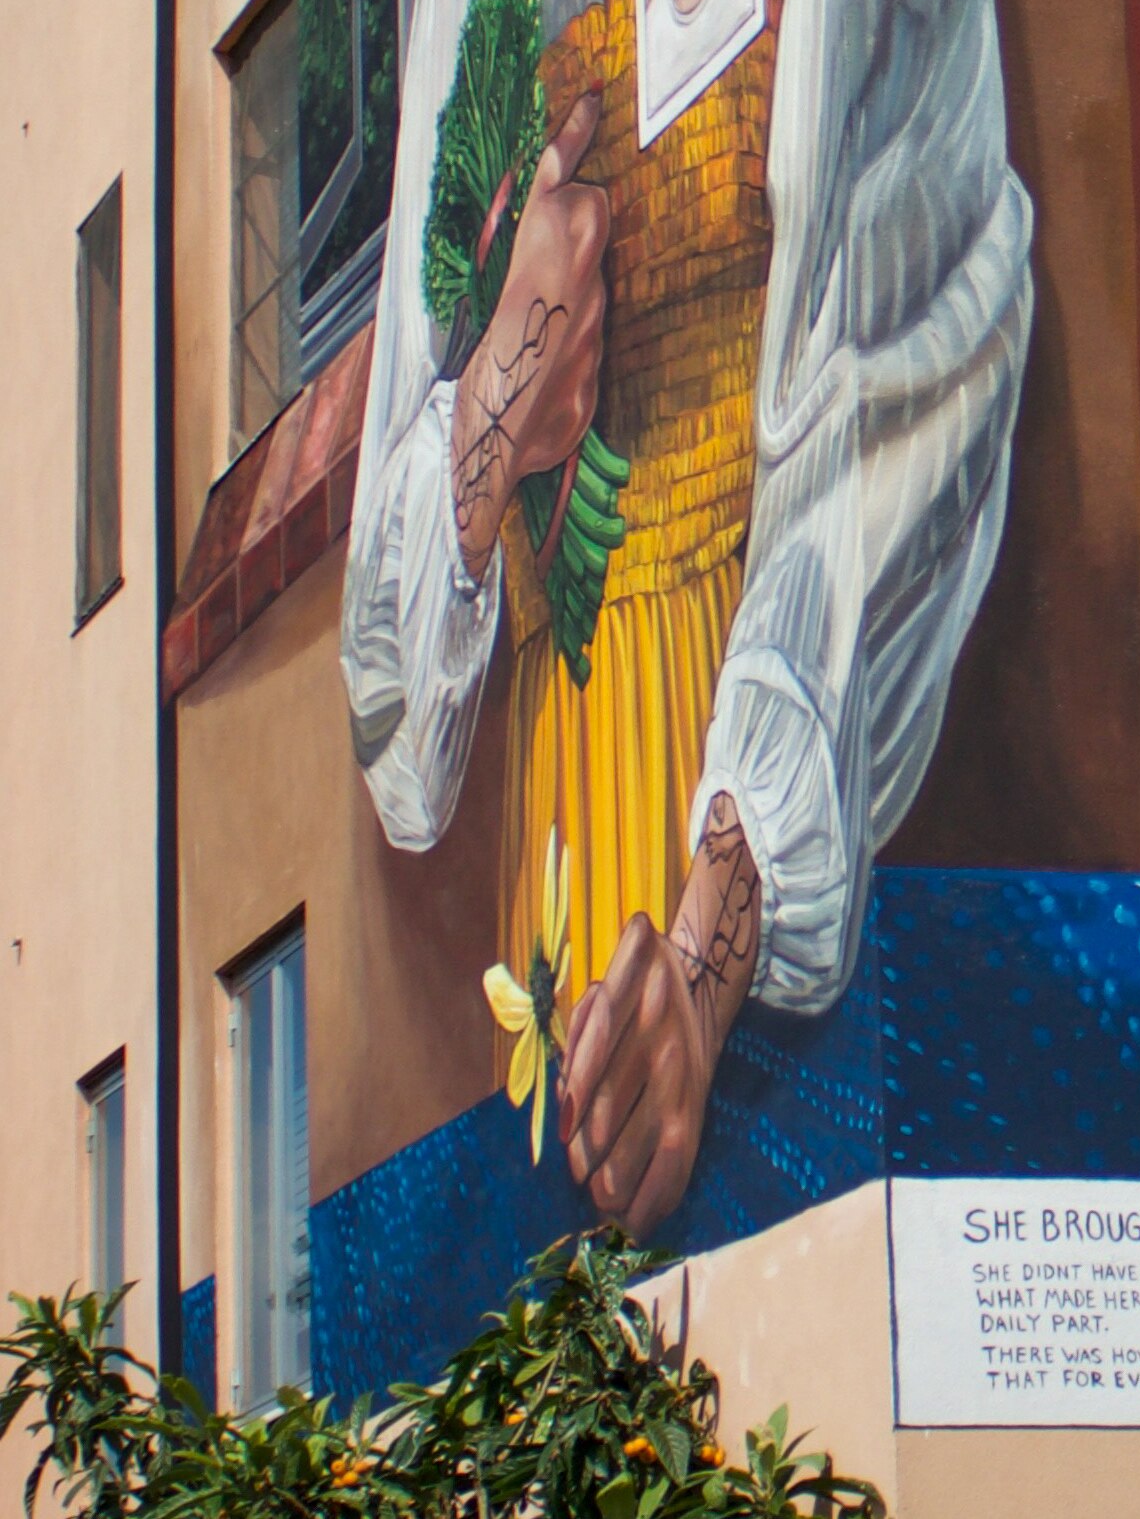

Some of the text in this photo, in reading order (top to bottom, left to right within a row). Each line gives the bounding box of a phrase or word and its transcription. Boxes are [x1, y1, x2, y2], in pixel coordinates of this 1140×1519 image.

[962, 1208, 1027, 1244] SHE
[972, 1263, 1011, 1284] SHE
[1091, 1263, 1137, 1281] HAVE
[975, 1287, 1036, 1309] WHAT
[1044, 1288, 1096, 1309] MADE
[980, 1312, 1109, 1334] DAILY PART.
[980, 1345, 1054, 1365] THERE
[1060, 1347, 1103, 1365] WAS
[986, 1369, 1049, 1390] THAT
[1062, 1368, 1105, 1388] FOR
